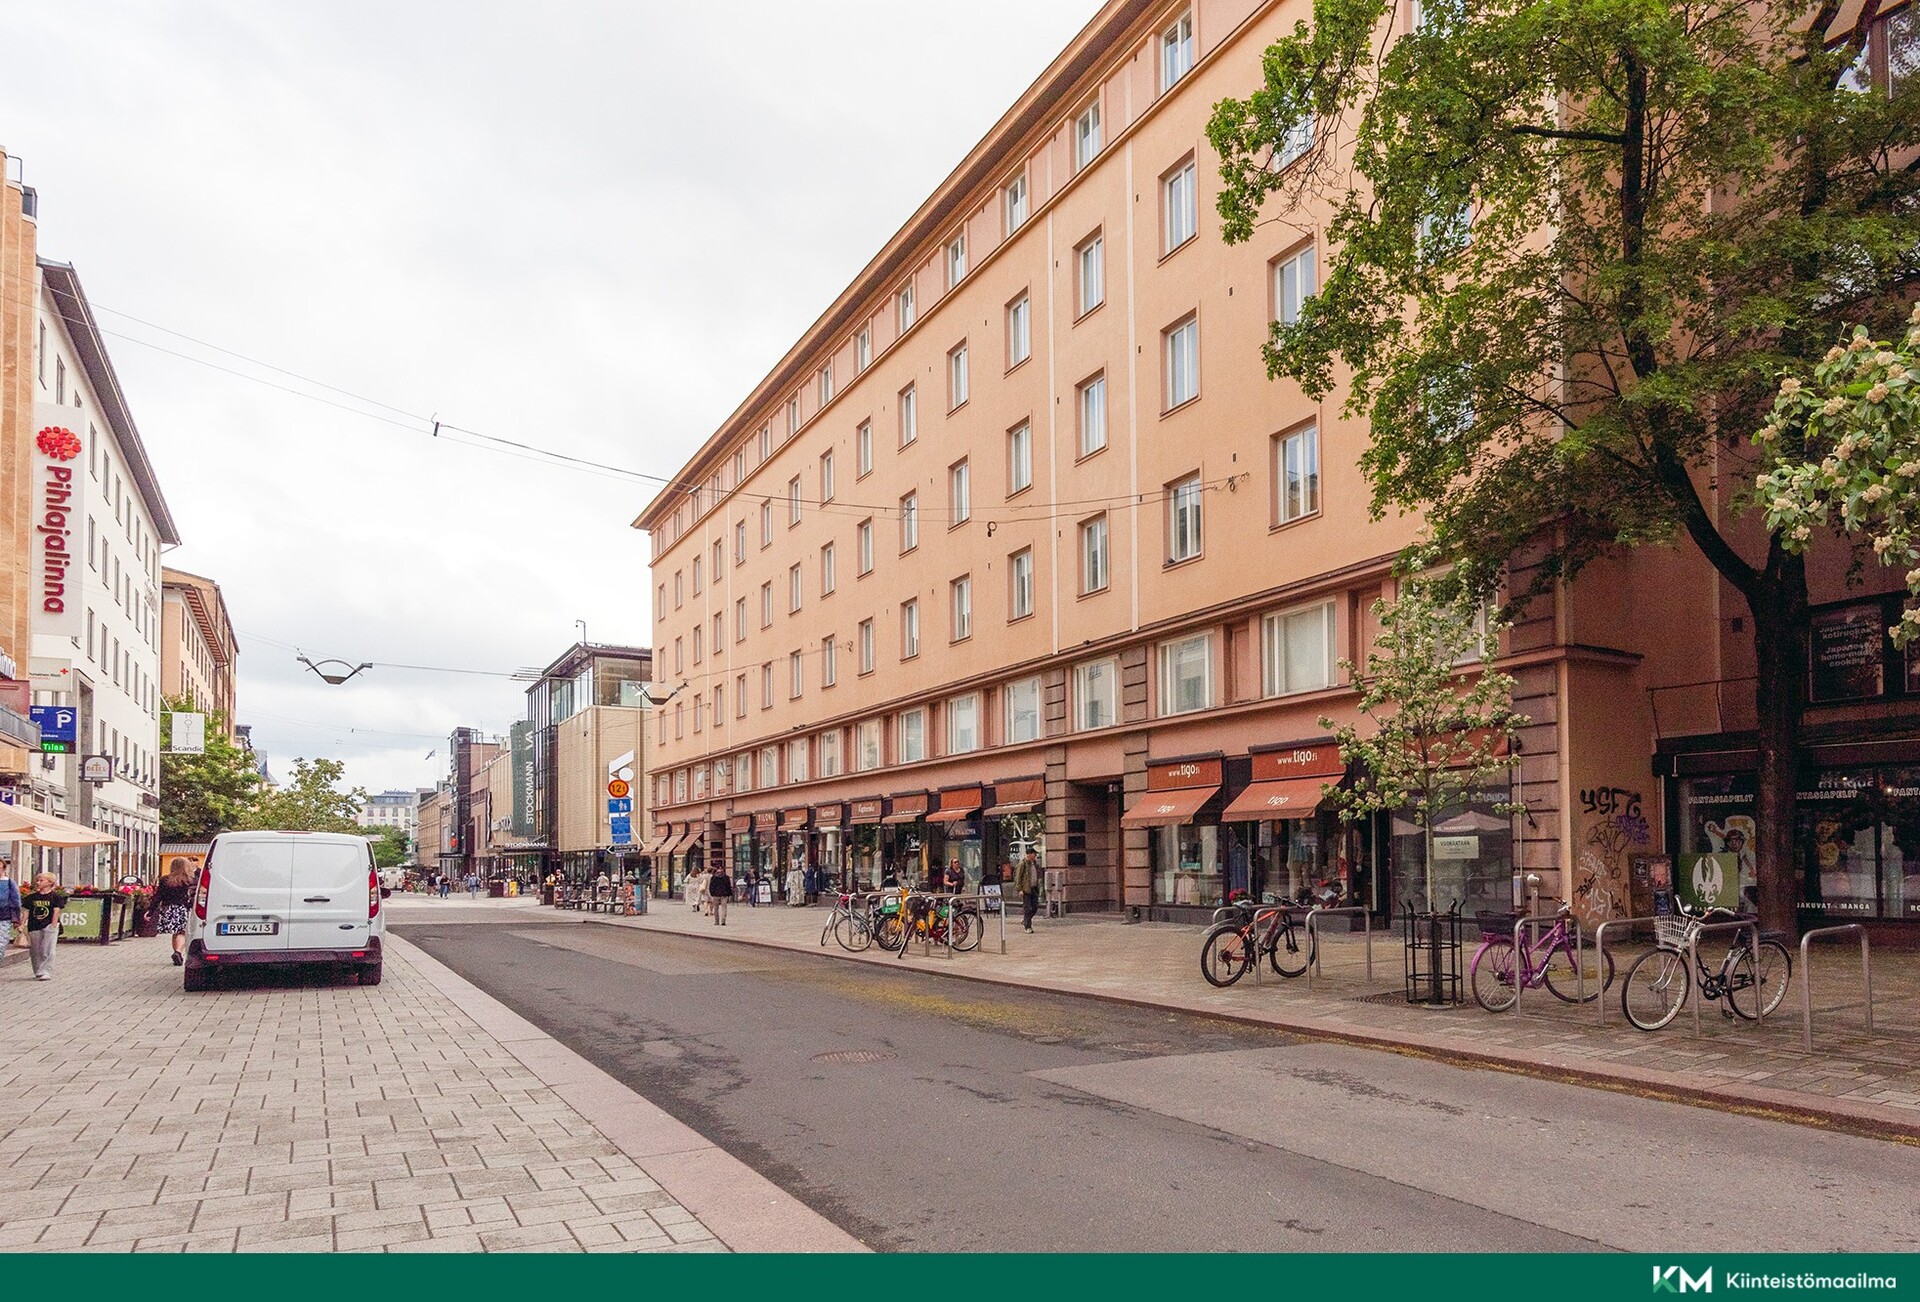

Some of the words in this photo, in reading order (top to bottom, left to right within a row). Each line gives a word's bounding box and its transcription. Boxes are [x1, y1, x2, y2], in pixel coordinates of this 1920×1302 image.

[37, 465, 72, 613] Pihlajalinna
[57, 714, 72, 728] P
[172, 744, 203, 752] Scandic
[525, 761, 534, 825] STOCKMANN
[1796, 789, 1858, 801] NTASIAPELIT
[1893, 786, 1920, 797] FANT
[1841, 902, 1870, 910] MANGA
[229, 923, 271, 932] RVK-413
